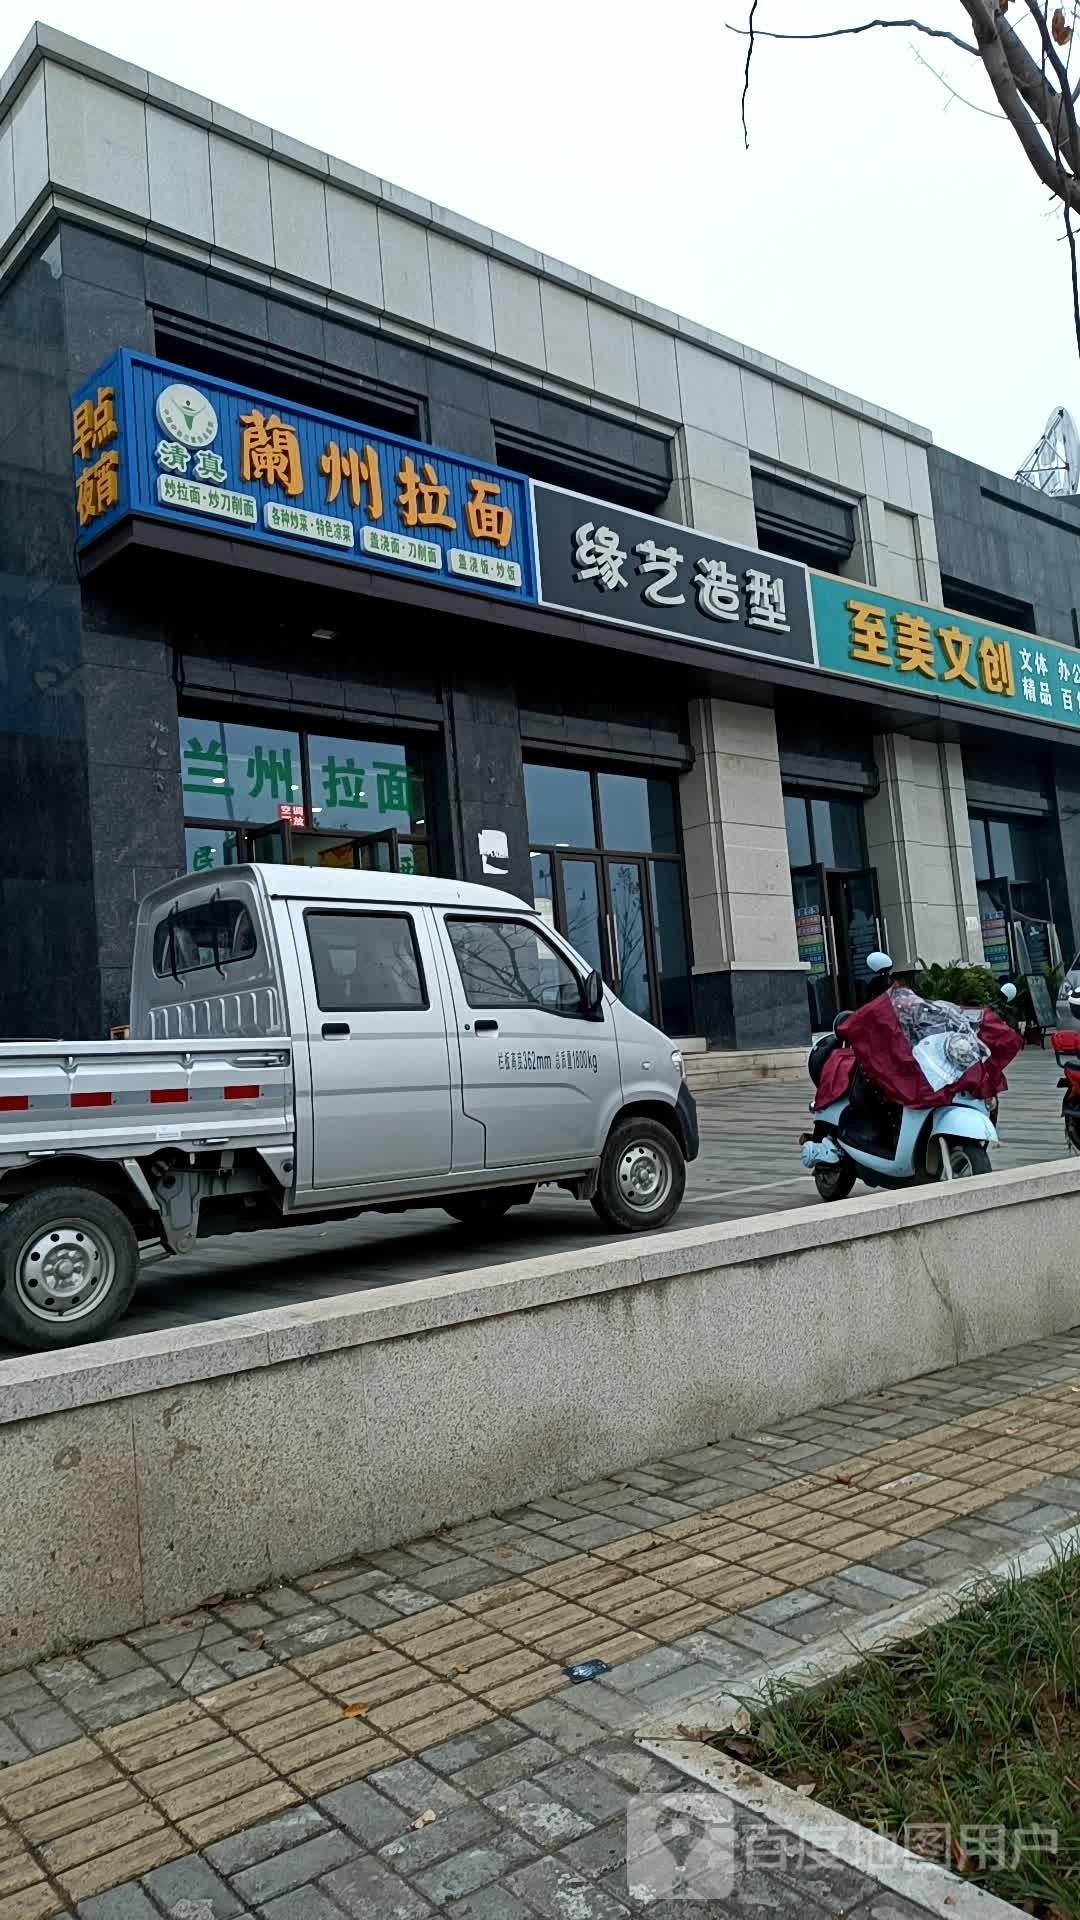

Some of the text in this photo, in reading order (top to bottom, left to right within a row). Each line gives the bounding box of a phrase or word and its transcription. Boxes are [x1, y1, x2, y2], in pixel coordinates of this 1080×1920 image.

[73, 387, 117, 459] 早点
[76, 450, 118, 526] 夜宵
[156, 440, 227, 482] 清真
[573, 521, 791, 632] 缘艺造型
[847, 600, 1015, 697] 至美文创
[1019, 648, 1048, 676] 文体
[1022, 676, 1052, 706] 精品
[183, 737, 416, 814] 兰州拉面
